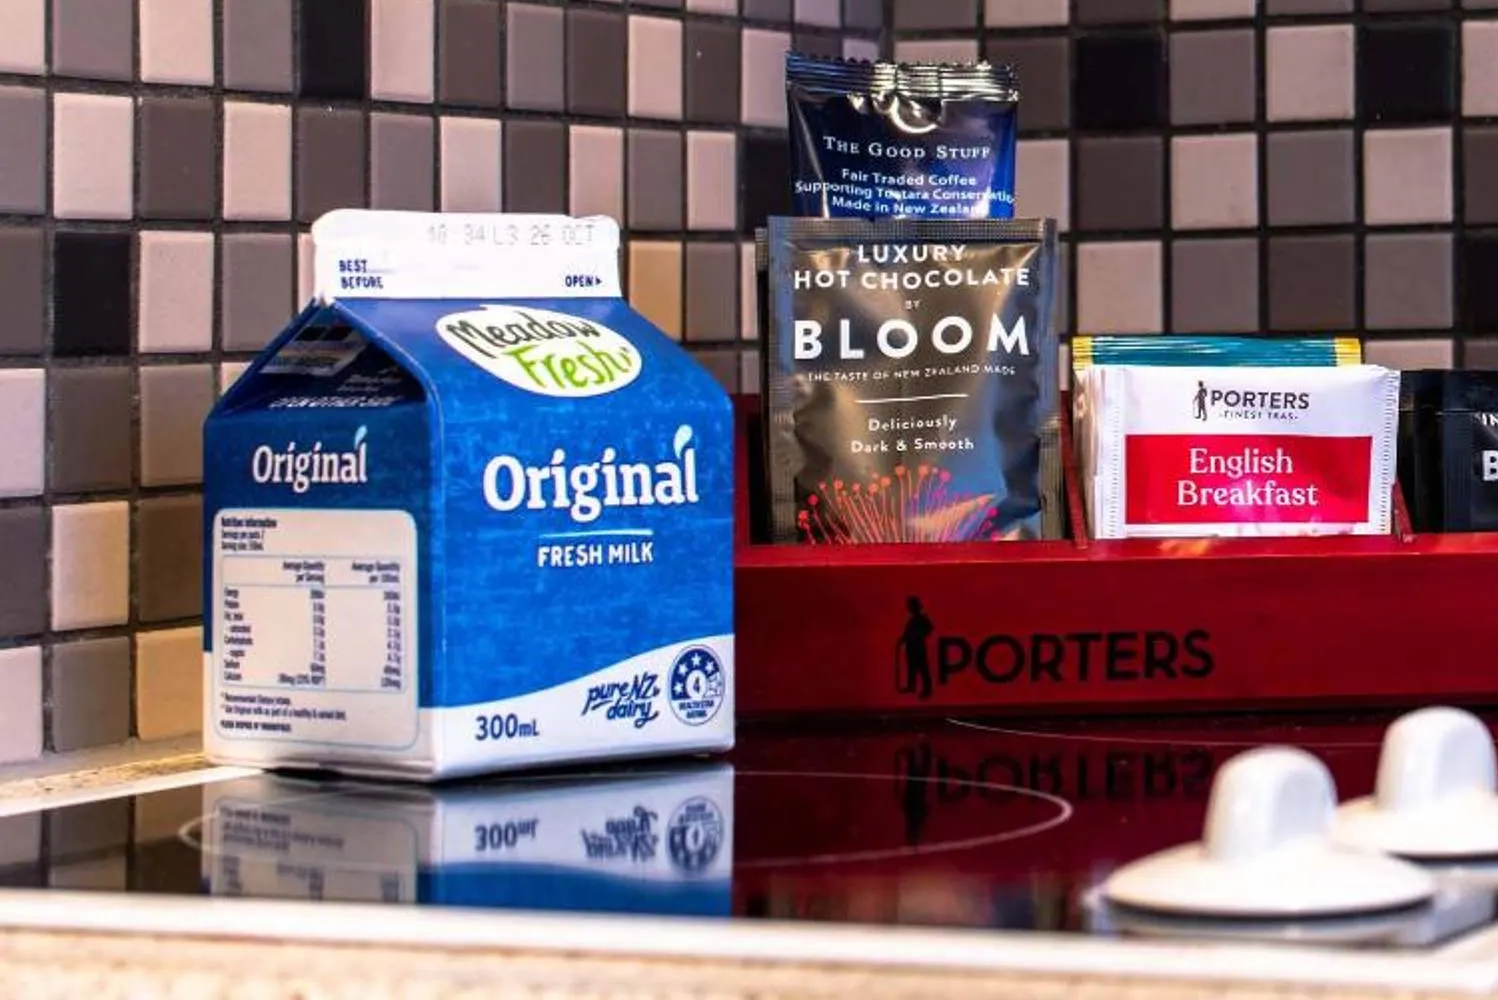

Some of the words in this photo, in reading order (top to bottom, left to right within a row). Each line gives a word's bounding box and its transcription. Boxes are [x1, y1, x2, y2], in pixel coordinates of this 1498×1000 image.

[823, 136, 860, 154] THE
[868, 142, 926, 158] GOOD
[936, 145, 991, 159] STUFF
[841, 167, 868, 182] Fair
[871, 171, 925, 186] Traded
[928, 173, 977, 187] Coffee
[795, 180, 872, 199] Supporting
[831, 196, 872, 212] Made
[874, 201, 890, 213] in
[893, 203, 927, 216] New
[930, 203, 988, 216] Zealan
[857, 244, 967, 264] LUXURY
[338, 259, 368, 273] BEST
[340, 275, 384, 289] BEFORE
[564, 275, 595, 288] OPEN
[794, 270, 851, 290] HOT
[861, 268, 1030, 291] CHOCOLATE
[446, 310, 601, 359] Meadow
[793, 312, 1030, 360] BLOOM
[501, 340, 630, 389] Fresh
[834, 371, 869, 382] TASTE
[924, 364, 981, 378] ZEALAND
[1210, 389, 1310, 410] PORTERS
[867, 414, 958, 432] Deliciously
[850, 439, 889, 454] Dark
[896, 439, 908, 452] &
[913, 437, 975, 450] Smooth
[252, 440, 368, 494] Original
[1188, 448, 1294, 477] English
[483, 447, 699, 523] Original
[1177, 479, 1319, 508] Breakfast
[537, 544, 603, 568] FRESH
[608, 542, 654, 566] MILK
[937, 628, 1215, 684] PORTERS
[606, 699, 659, 729] dairy
[475, 713, 540, 741] 300mL
